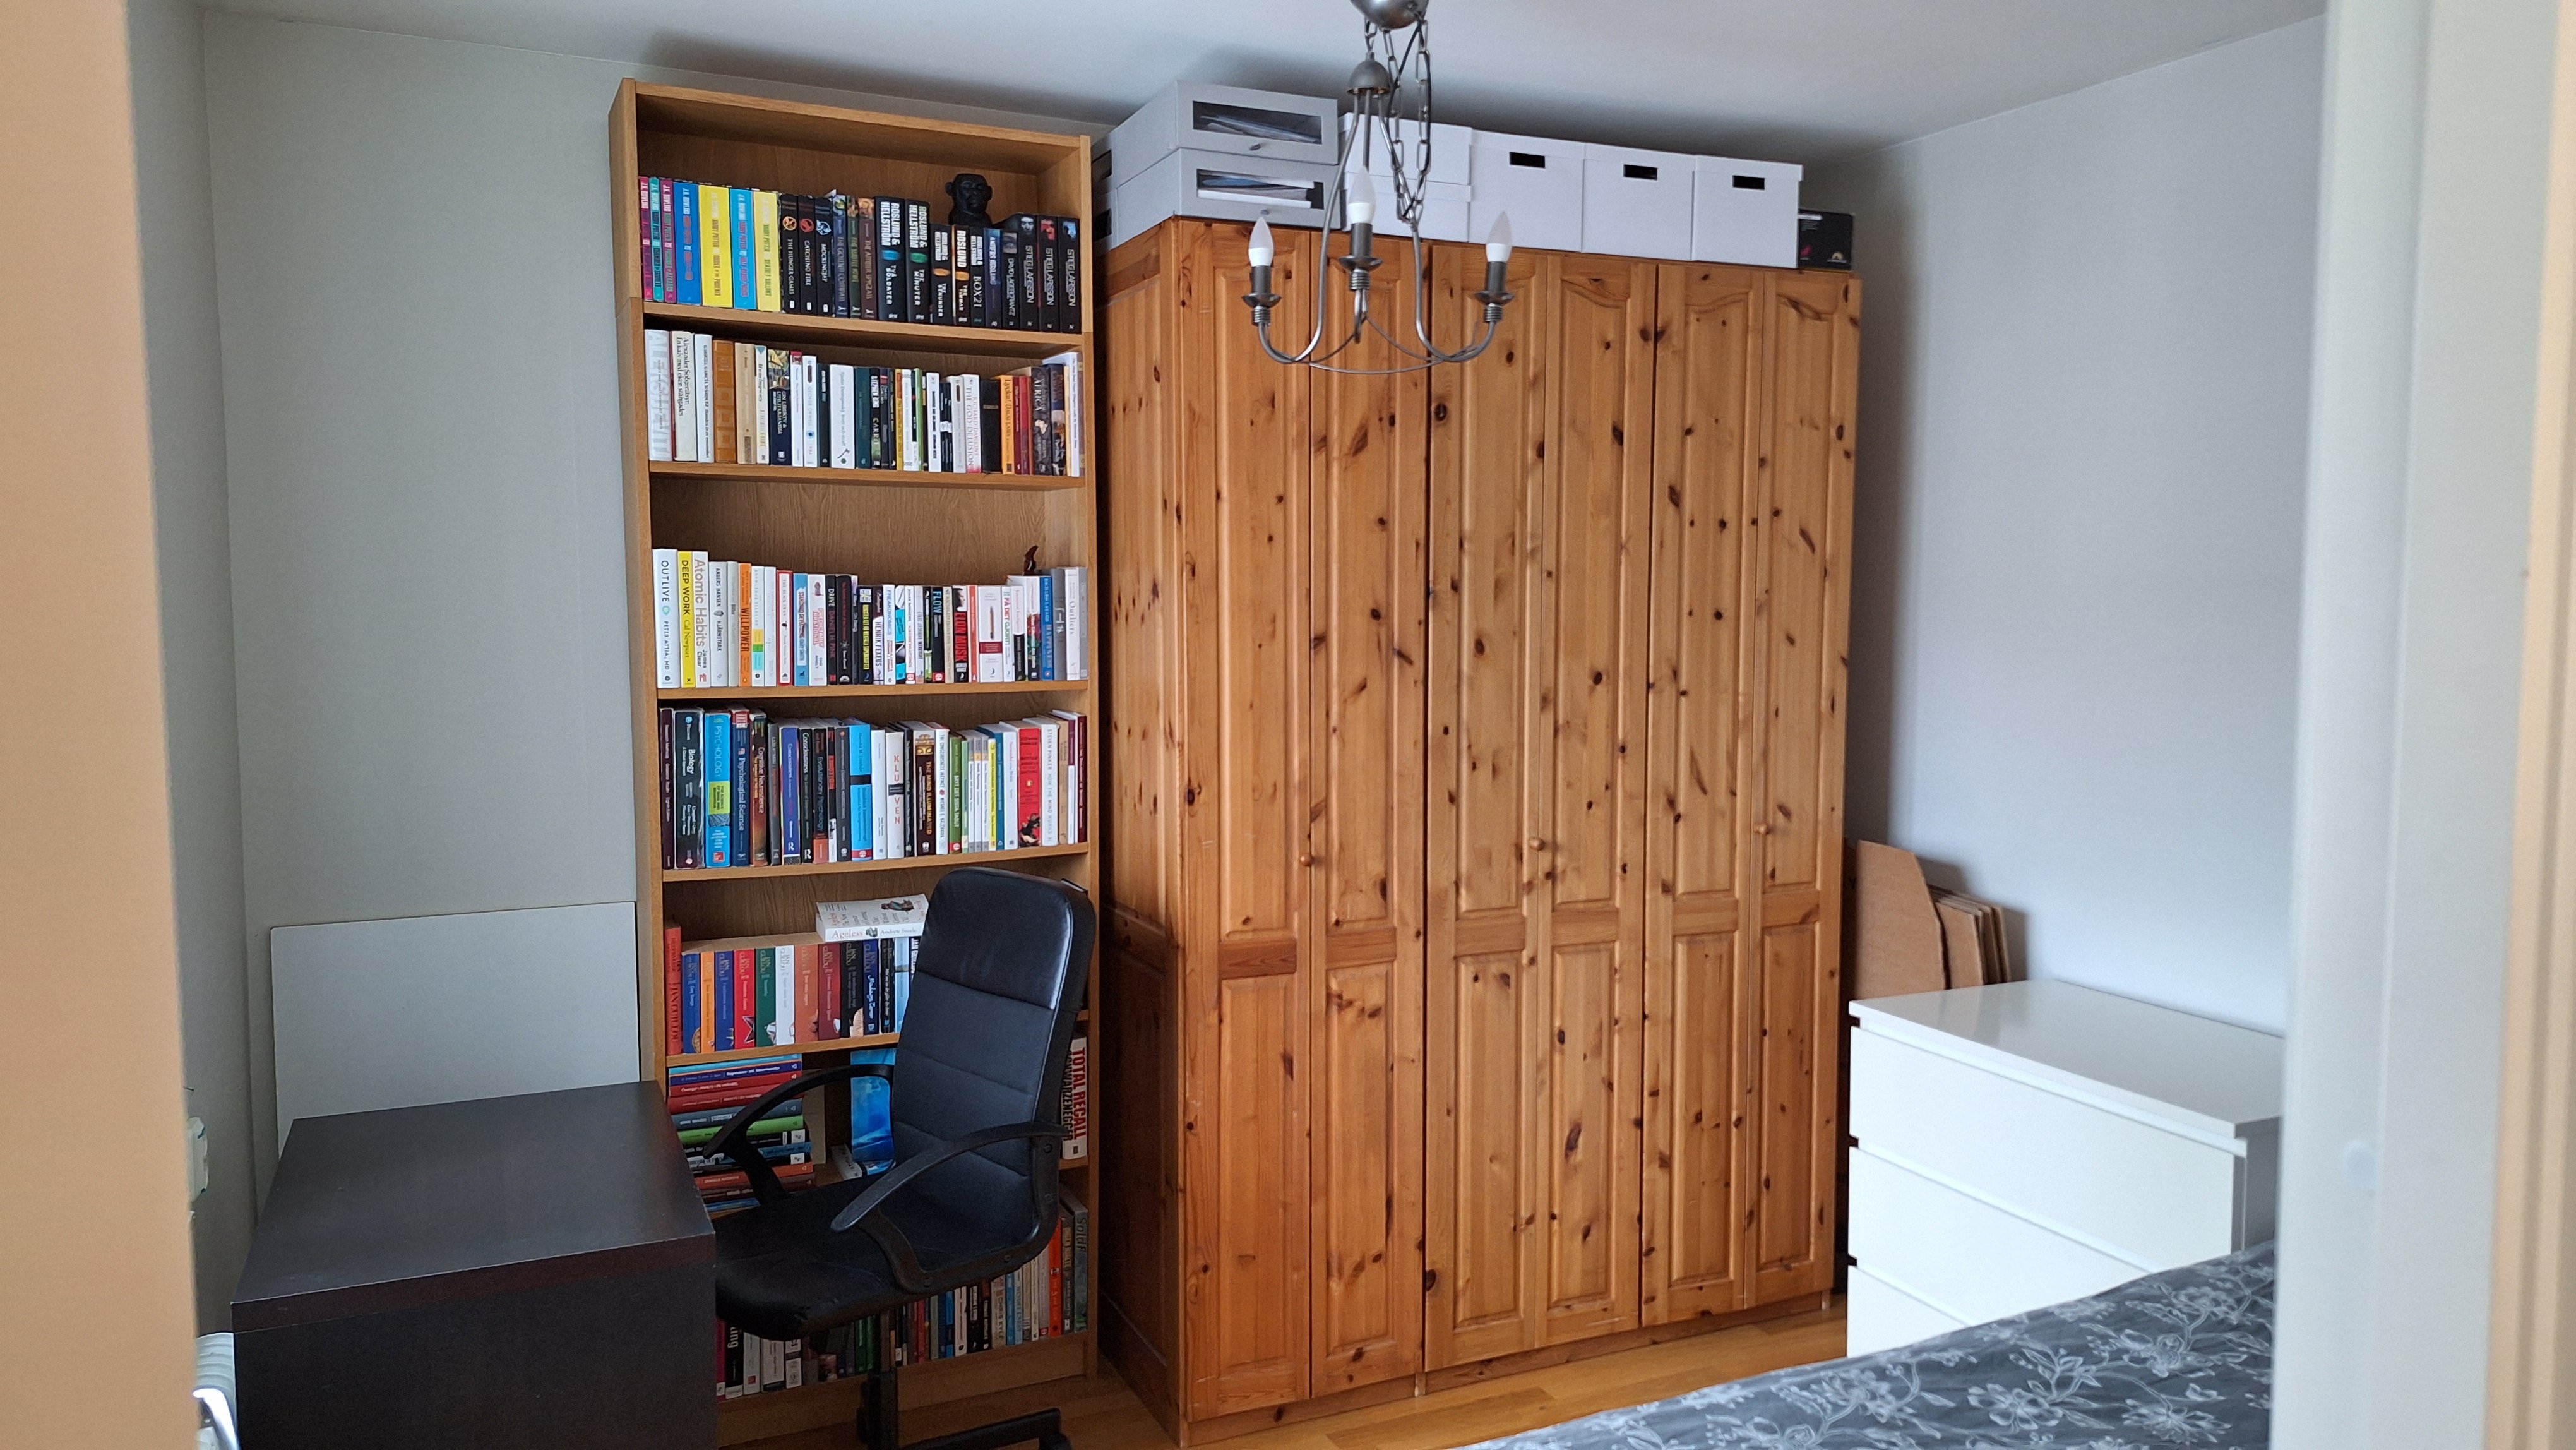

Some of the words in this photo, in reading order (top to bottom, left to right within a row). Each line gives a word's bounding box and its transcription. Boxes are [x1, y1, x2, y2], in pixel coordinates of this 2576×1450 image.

[881, 202, 891, 246] HELLSTRÖM
[891, 203, 900, 237] ROSLUND
[909, 205, 918, 248] HELLSTRÖM
[957, 230, 966, 267] ROSLUND
[661, 561, 669, 602] OUTLIVE
[694, 559, 705, 604] Atomic
[933, 591, 941, 613] FLOW
[696, 608, 707, 647] Habits
[741, 608, 749, 652] WILLPOWER
[955, 613, 967, 633] ELON
[664, 661, 669, 670] MD
[955, 636, 967, 661] MUSK
[687, 749, 696, 774] Biology
[832, 930, 863, 938] Ageless
[671, 987, 679, 1002] JAN
[671, 1004, 679, 1041] GUILLOU
[1073, 1047, 1086, 1089] TOTAL
[1073, 1091, 1087, 1140] RECALL
